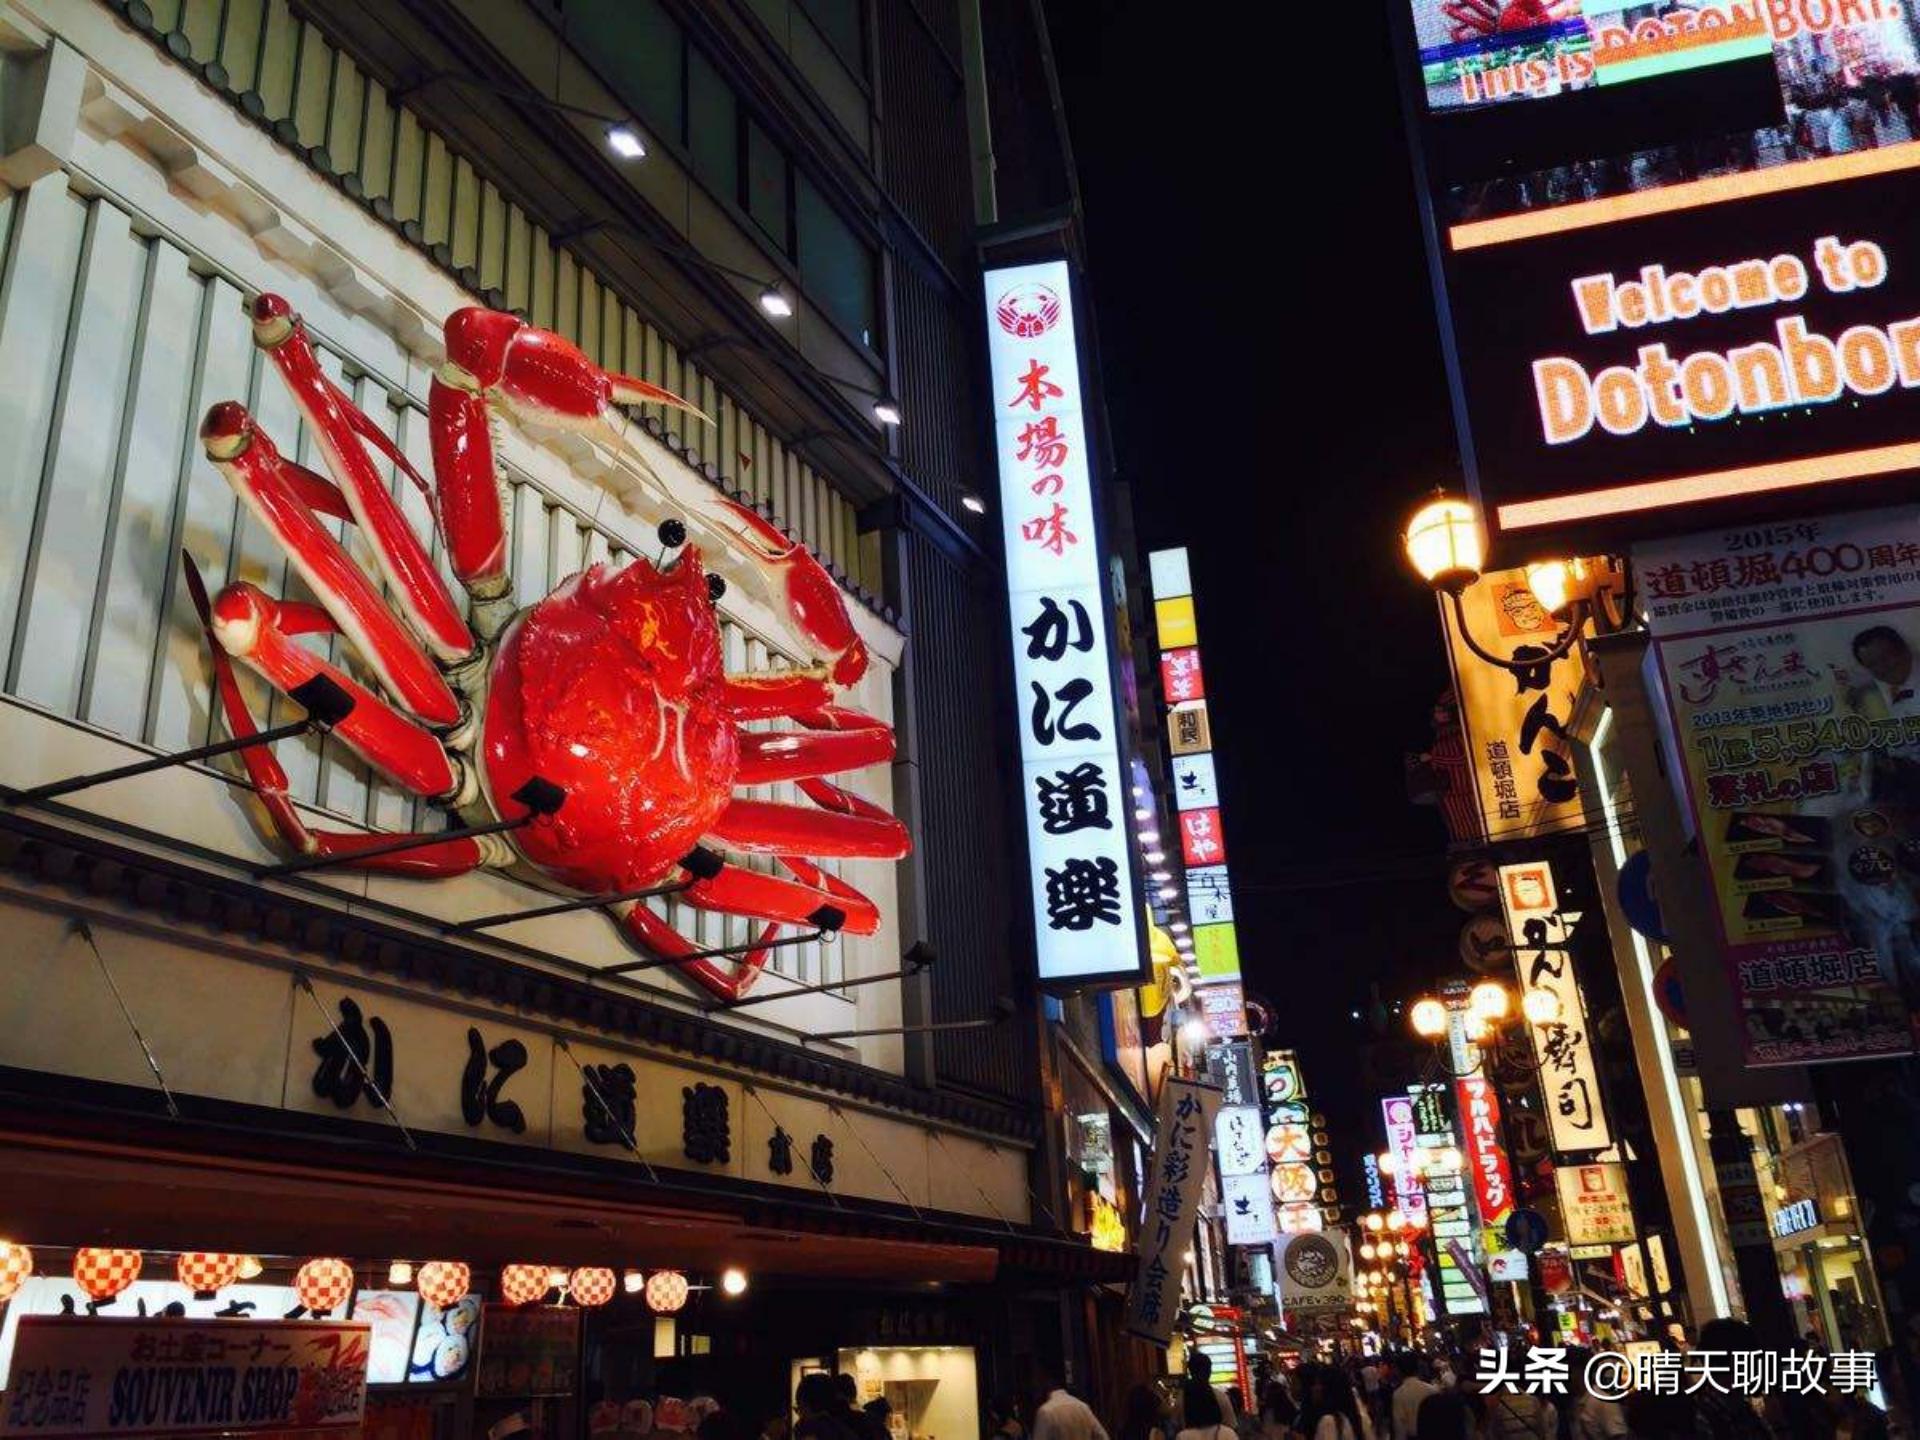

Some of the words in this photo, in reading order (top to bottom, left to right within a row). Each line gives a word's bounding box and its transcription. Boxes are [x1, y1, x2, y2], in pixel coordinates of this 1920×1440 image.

[1572, 252, 1809, 336] Welcome
[1815, 234, 1889, 293] to
[1007, 358, 1080, 558] 本場の味
[1723, 523, 1820, 552] 2015年
[1740, 948, 1882, 992] 道頓堀店
[132, 1332, 293, 1363] お土産コーナー
[110, 1366, 237, 1426] SOUVENIR
[238, 1366, 299, 1424] SHOP
